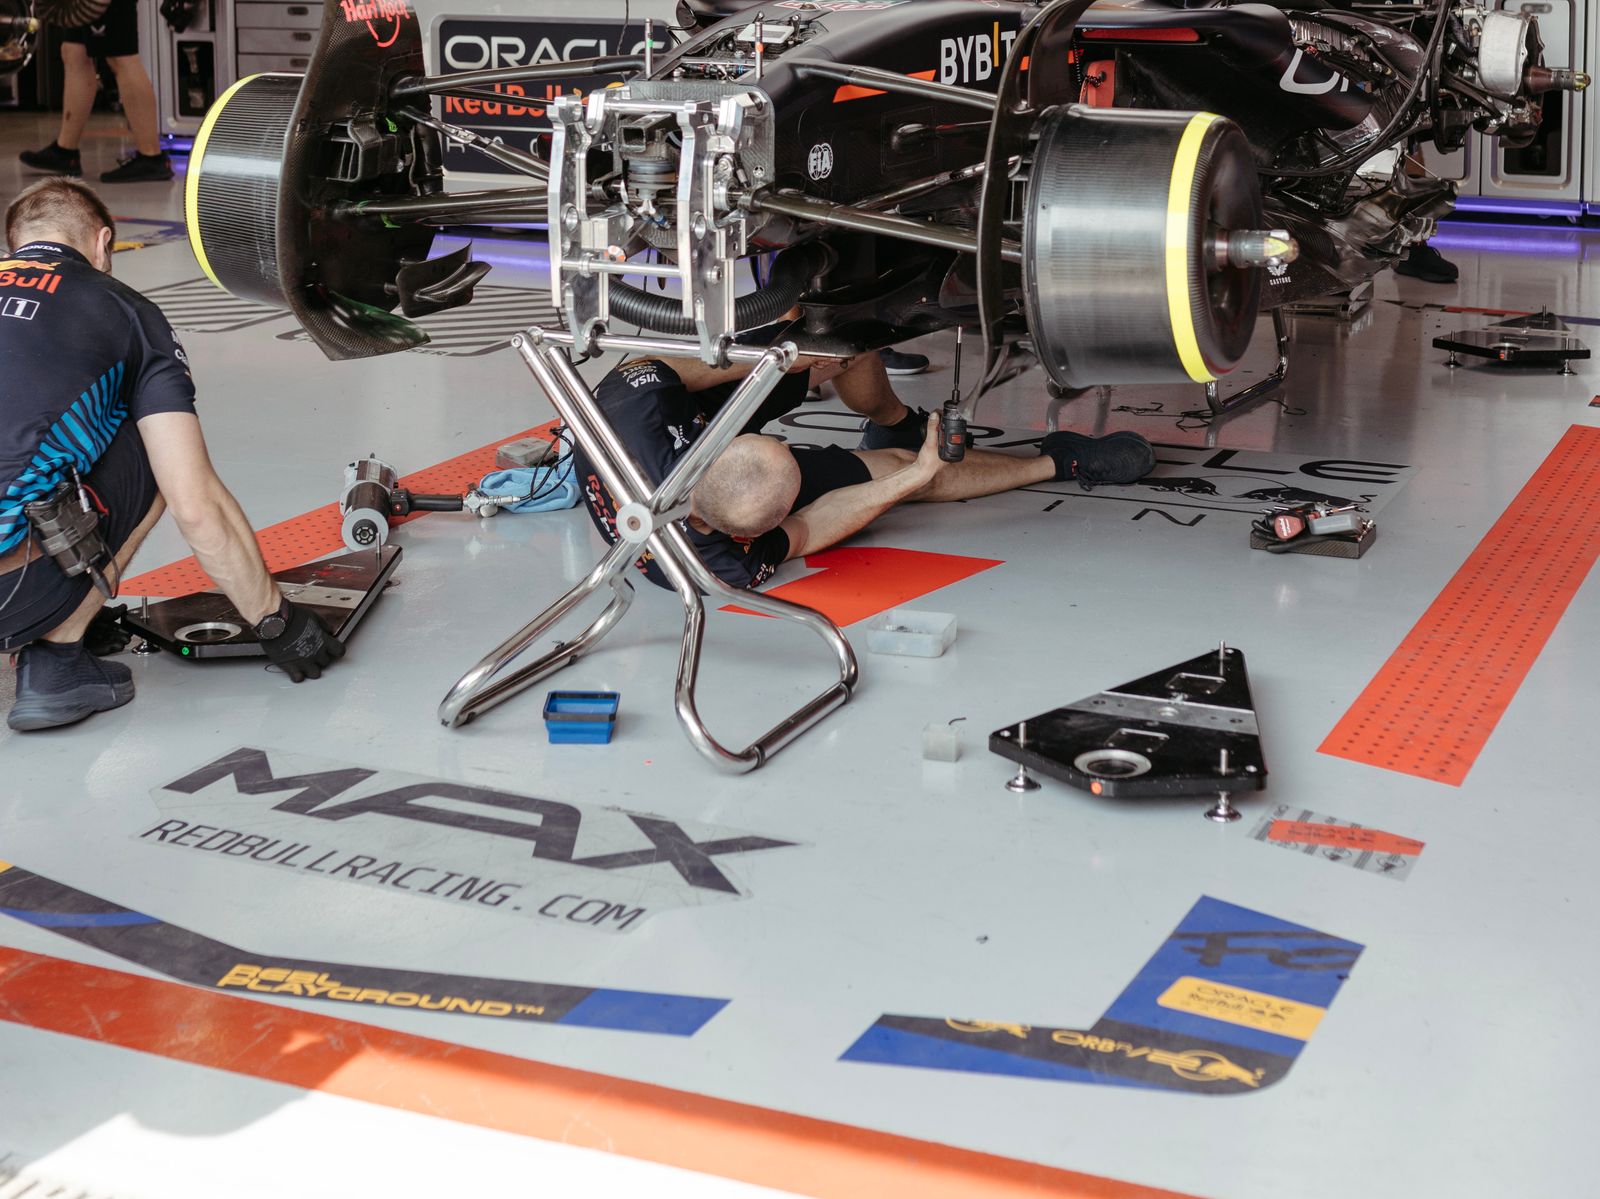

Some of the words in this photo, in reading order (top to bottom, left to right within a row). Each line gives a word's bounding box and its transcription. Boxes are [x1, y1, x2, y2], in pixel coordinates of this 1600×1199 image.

[940, 21, 1017, 85] BYBIT
[809, 151, 831, 173] FIA
[0, 271, 62, 294] Bull
[1269, 276, 1292, 286] CASTORE
[629, 373, 662, 389] VISA
[162, 747, 801, 895] MAX
[1196, 984, 1296, 1014] ORACLE
